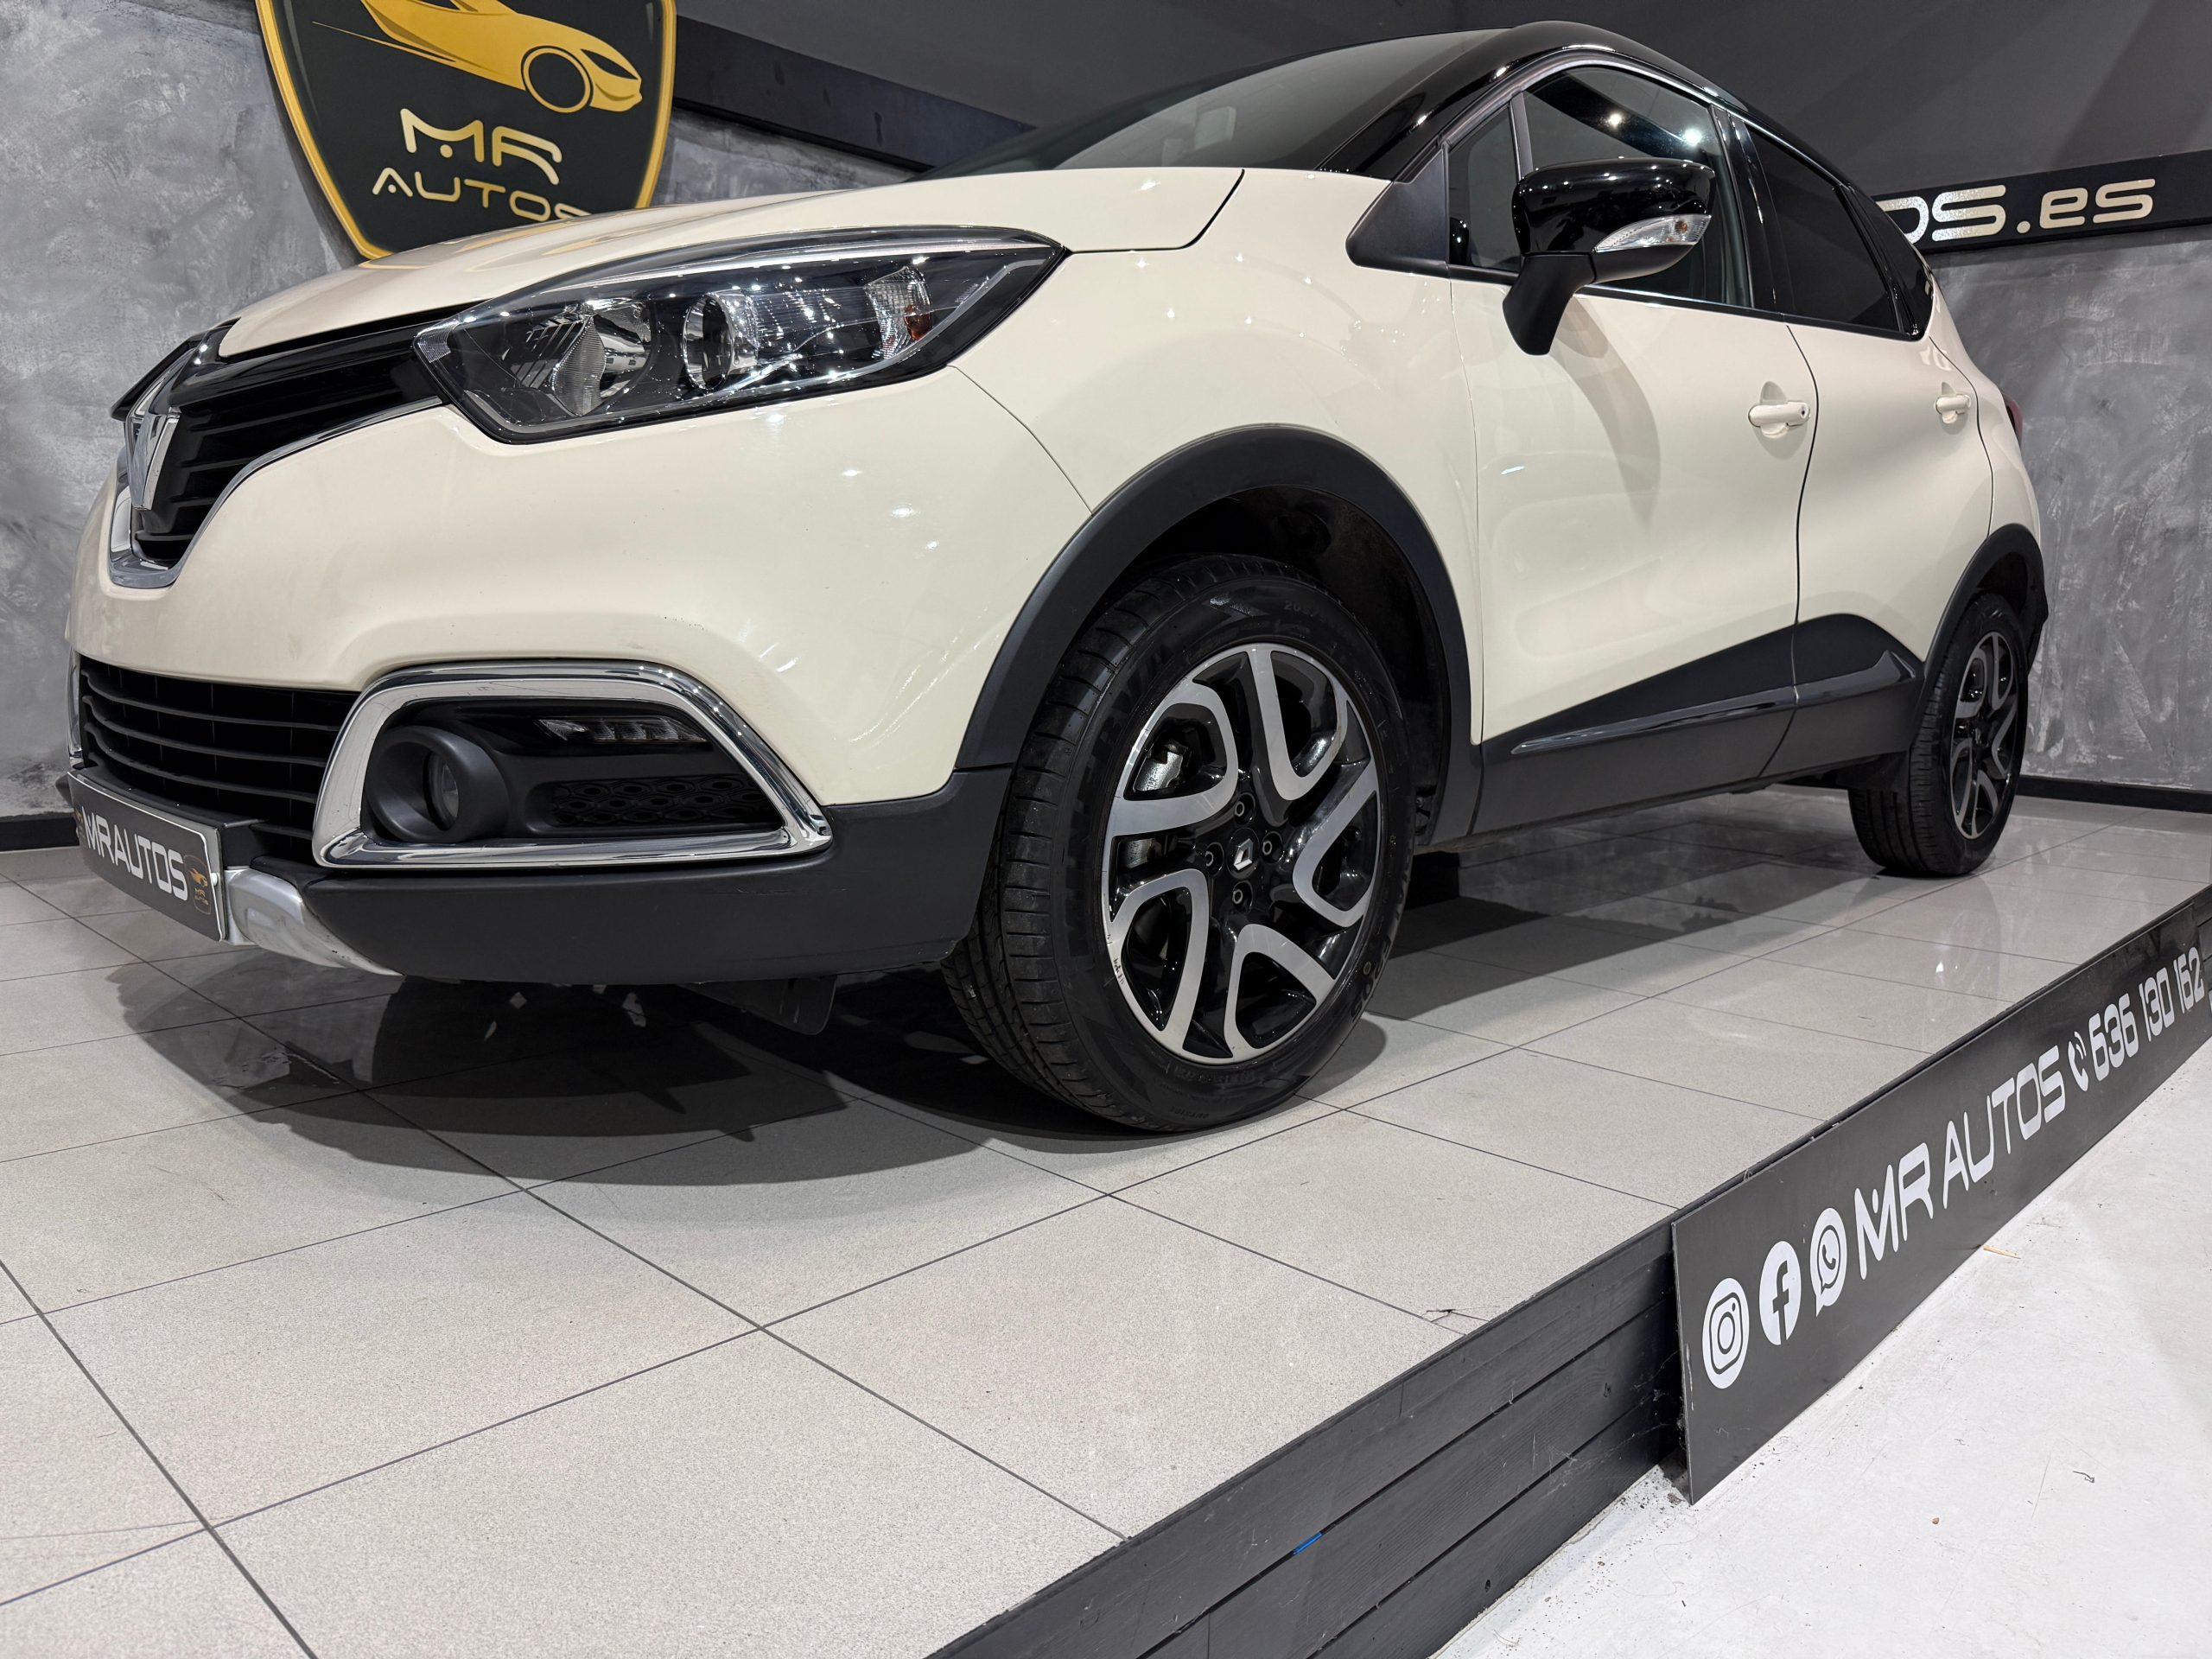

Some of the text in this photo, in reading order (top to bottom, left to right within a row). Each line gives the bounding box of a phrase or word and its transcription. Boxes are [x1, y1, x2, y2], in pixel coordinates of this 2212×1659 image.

[400, 108, 563, 185] MR
[1854, 947, 2205, 1280] MR AUTOS 636 130 162
